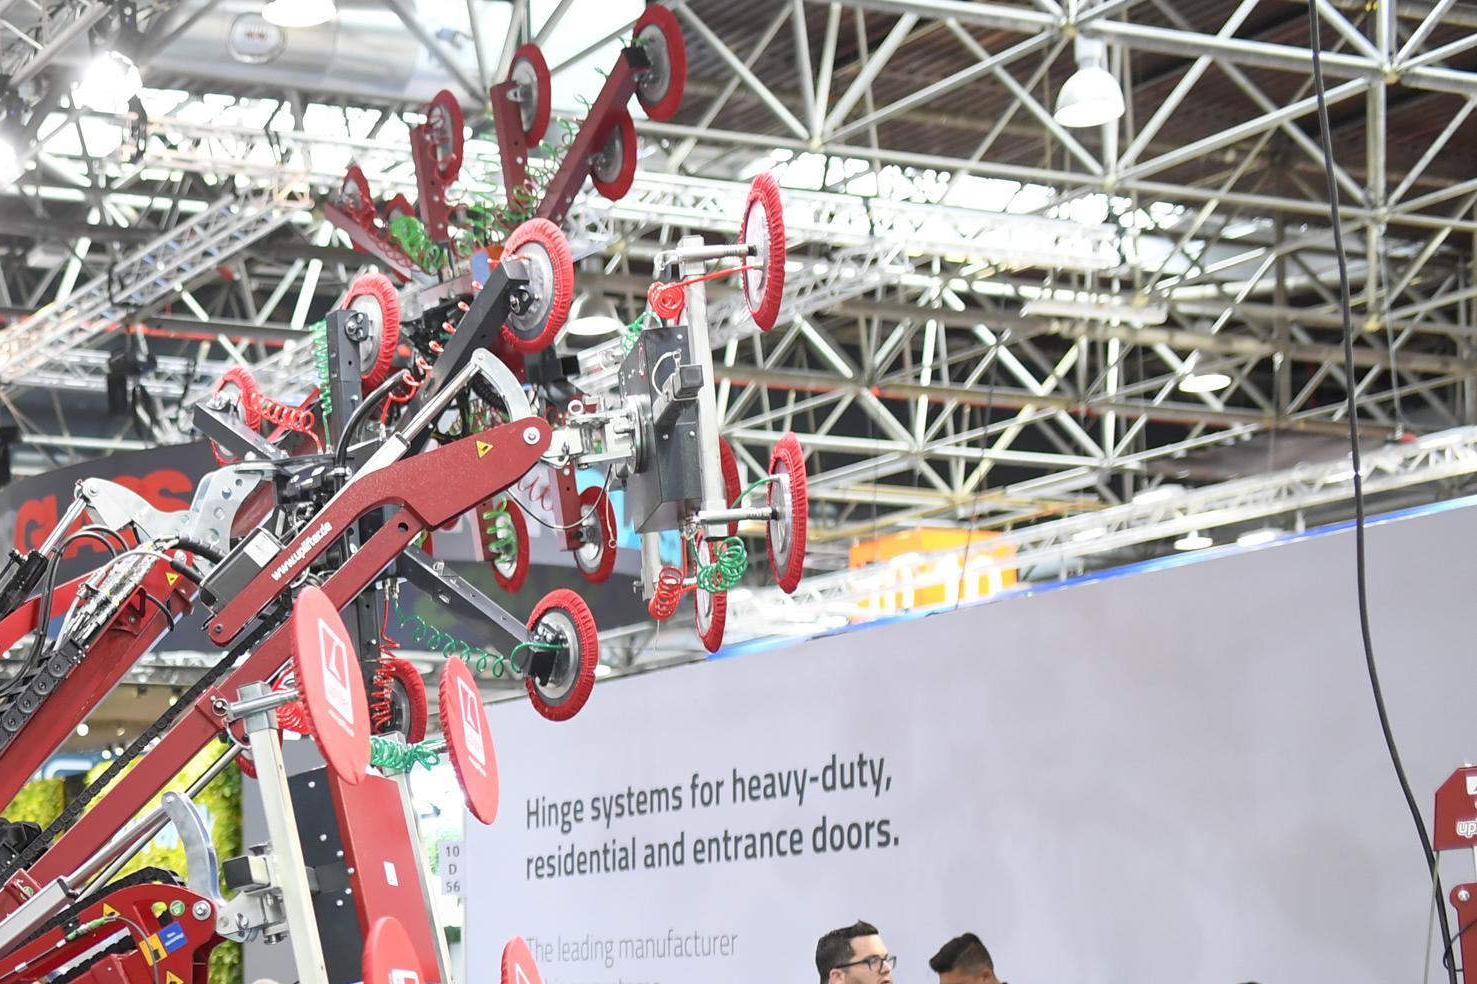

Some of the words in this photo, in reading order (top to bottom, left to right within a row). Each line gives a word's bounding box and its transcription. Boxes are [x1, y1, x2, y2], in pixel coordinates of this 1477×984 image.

[526, 796, 584, 835] Hinge
[591, 785, 683, 829] systems
[691, 773, 725, 808] for
[732, 753, 892, 806] heavy-duty,
[445, 845, 460, 857] 10
[526, 837, 636, 880] residential
[643, 831, 686, 869] and
[693, 830, 804, 864] entrance
[812, 816, 900, 854] doors.
[448, 863, 458, 876] D
[445, 881, 461, 893] 56
[558, 934, 614, 968] leading
[619, 929, 738, 960] manufacturer
